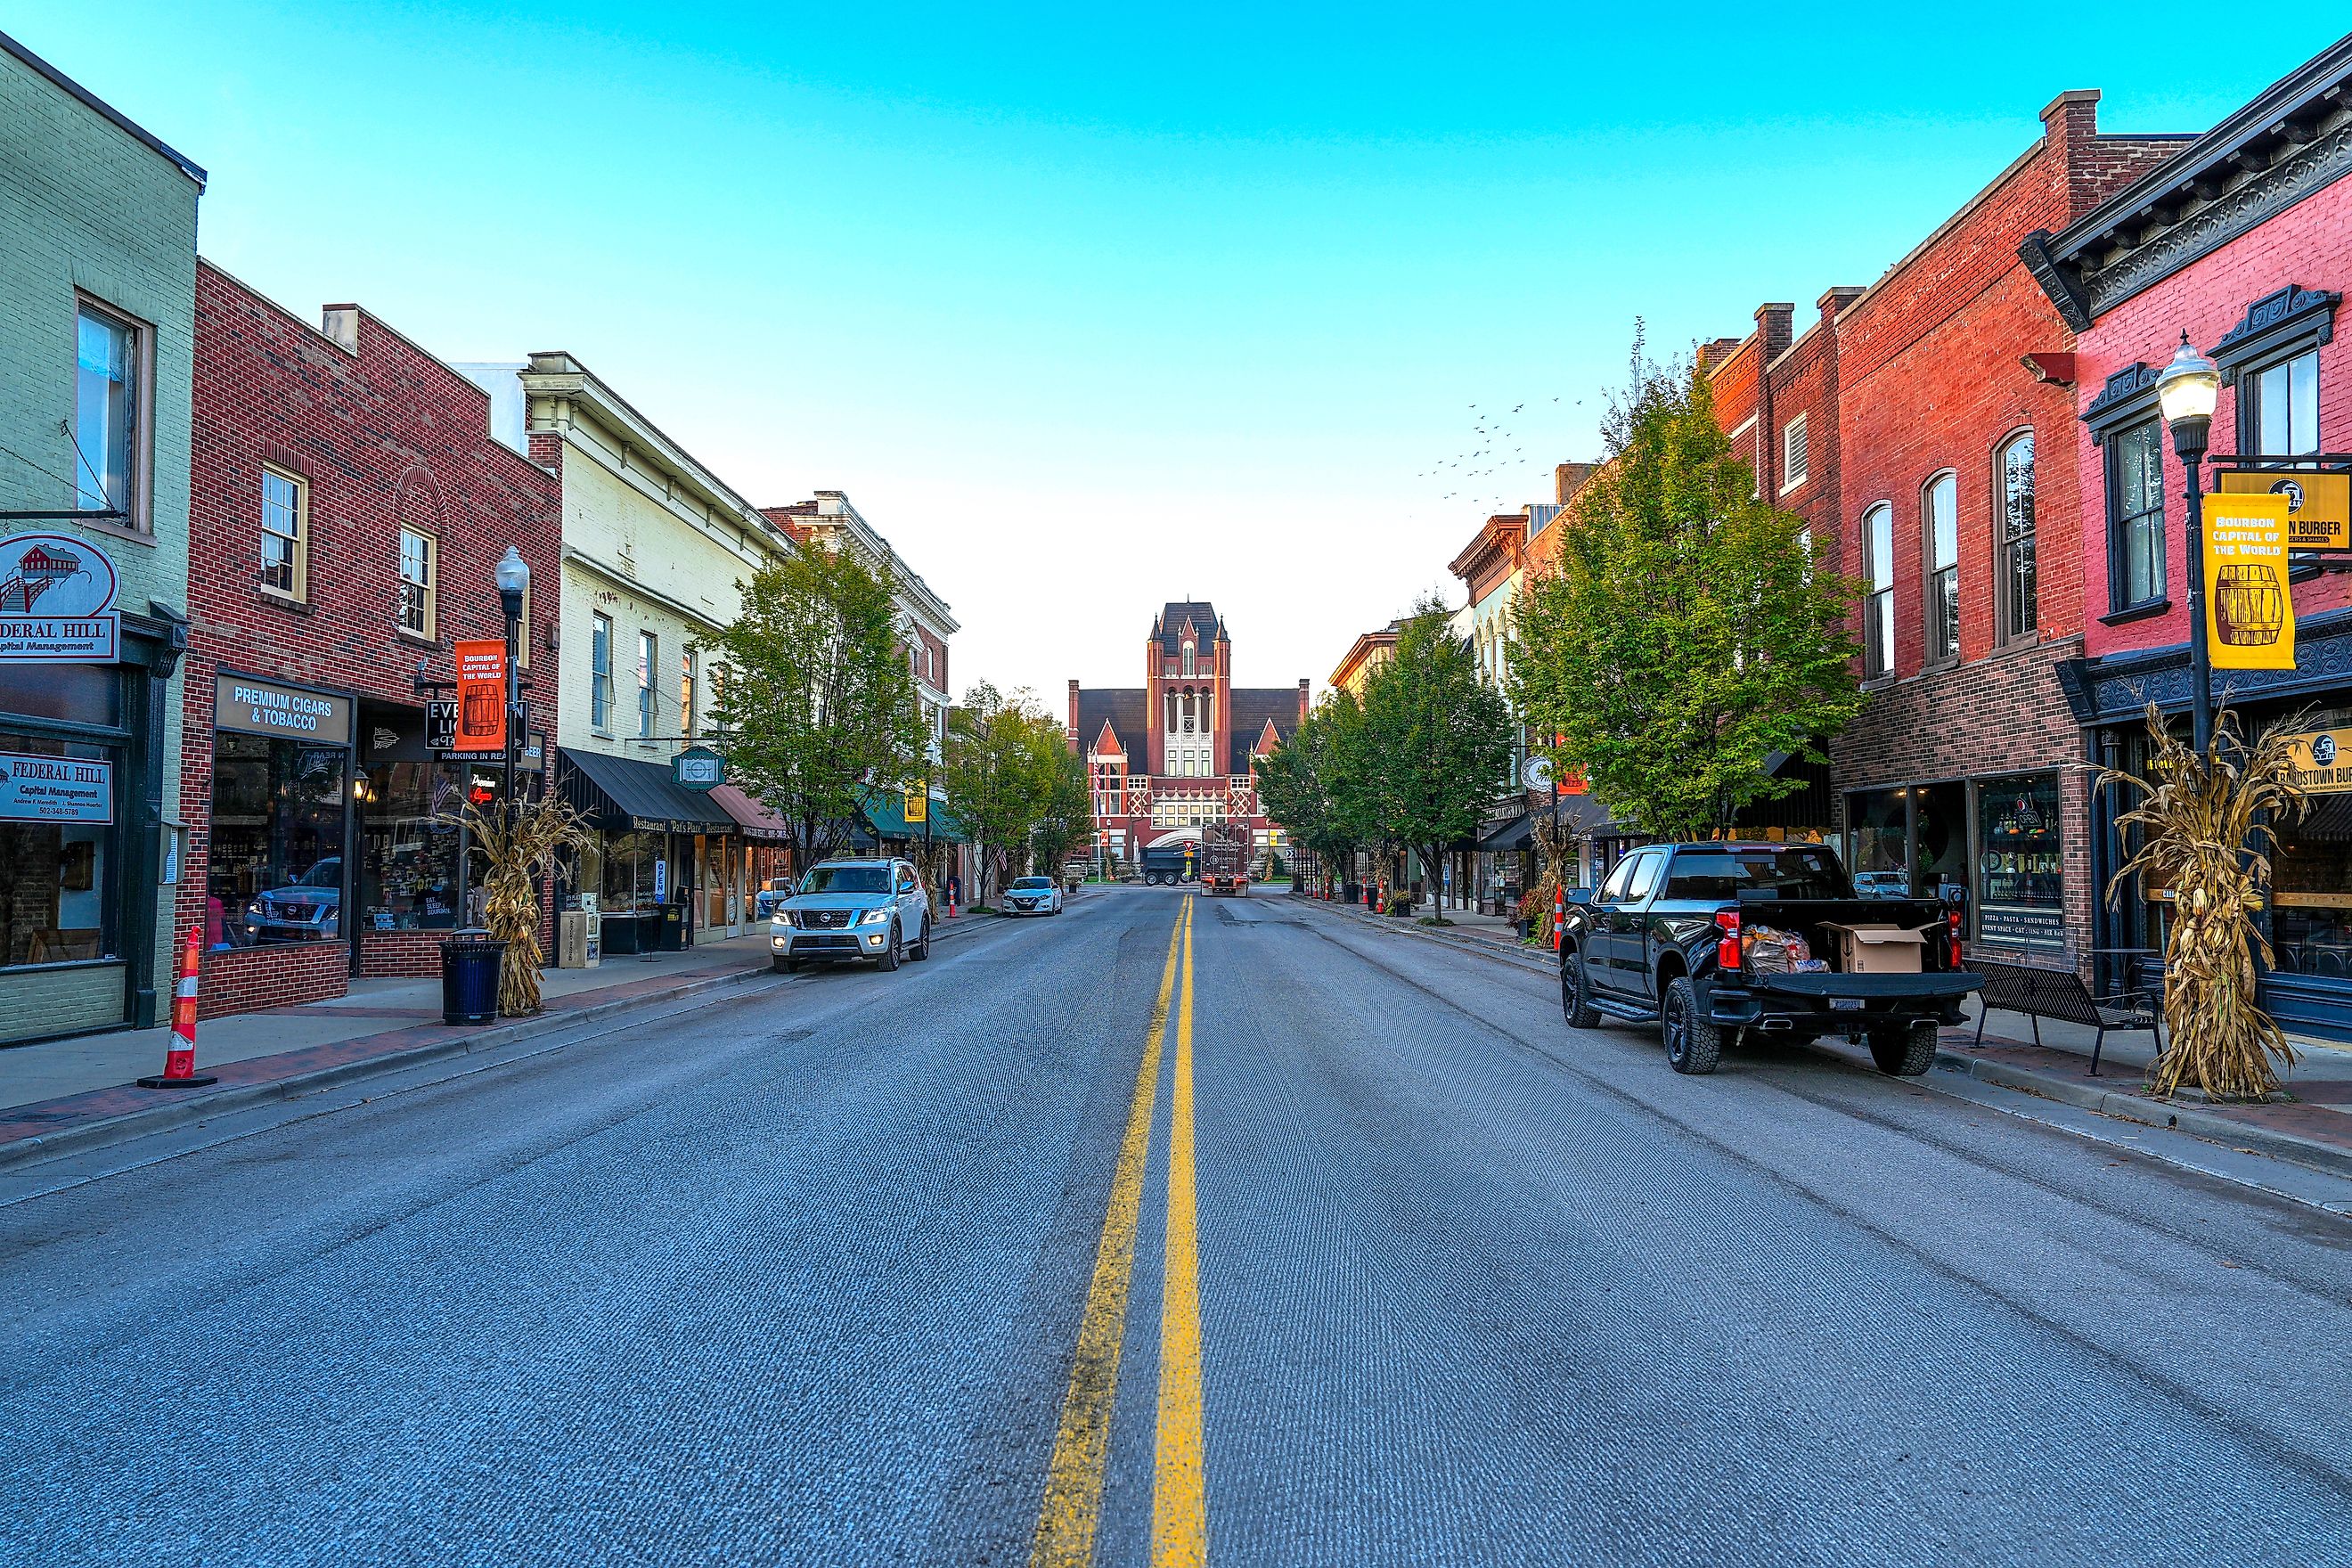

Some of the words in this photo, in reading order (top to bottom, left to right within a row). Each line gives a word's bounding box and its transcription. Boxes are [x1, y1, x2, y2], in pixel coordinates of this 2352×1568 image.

[2216, 517, 2274, 527] BOURBON
[2299, 521, 2340, 535] BURGER
[2213, 531, 2261, 542] CAPITAL
[2265, 533, 2280, 542] OF
[2213, 546, 2234, 555] THE
[2239, 544, 2281, 555] WORLD
[62, 623, 105, 638] HILL
[26, 642, 94, 652] Management
[234, 686, 290, 709] PREMIUM
[292, 696, 332, 717] CIGARS
[251, 707, 261, 723] &
[263, 709, 316, 731] TOBACCO
[441, 752, 478, 760] PARKING
[479, 752, 488, 760] IN
[490, 752, 506, 760] REA
[12, 762, 71, 781] FEDERAL
[74, 766, 105, 784] HILL
[20, 785, 47, 796] Capital
[48, 787, 98, 799] Management
[39, 807, 79, 816] 502-348-5789
[633, 816, 666, 832] Restaurant
[706, 823, 733, 833] Restaurant
[2024, 917, 2059, 926] SANDWICHES
[1981, 924, 1997, 932] EVENT
[1997, 925, 2012, 933] SPACE
